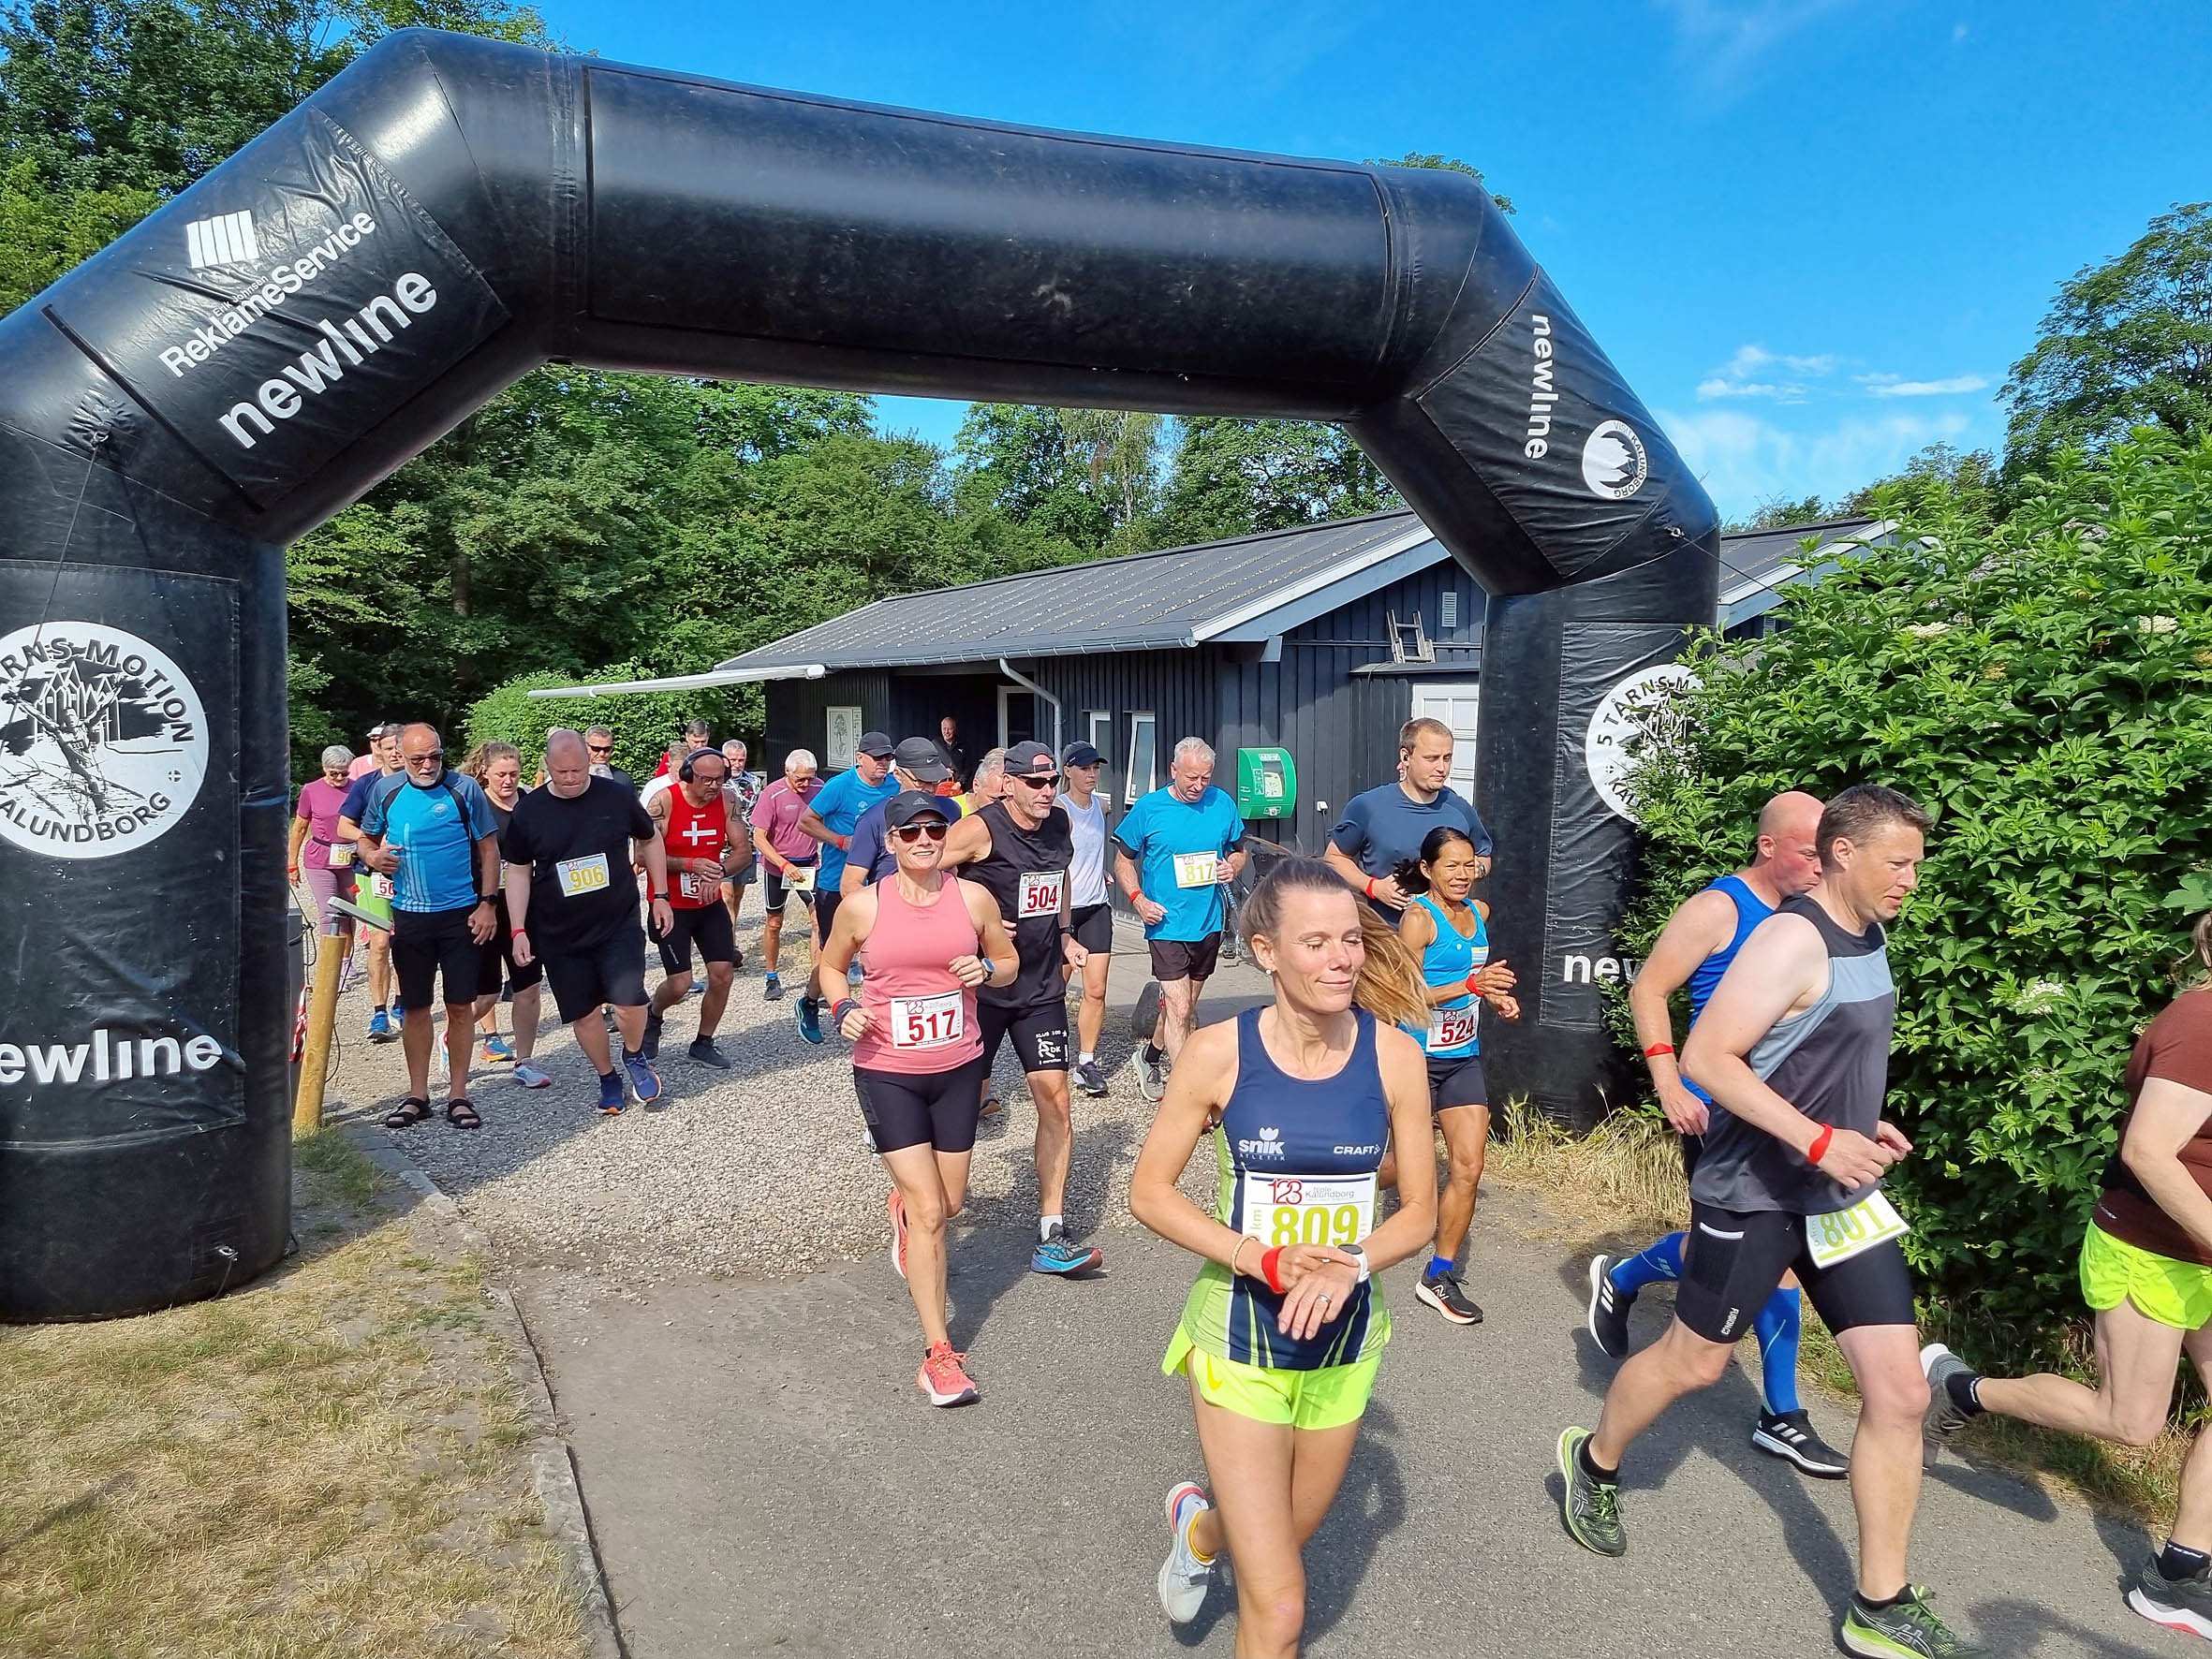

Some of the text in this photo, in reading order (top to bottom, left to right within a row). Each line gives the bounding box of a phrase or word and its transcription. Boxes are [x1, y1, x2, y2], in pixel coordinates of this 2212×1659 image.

[158, 212, 376, 377] ReklameService
[212, 275, 269, 316] Erik Johnsen
[218, 272, 438, 449] newline
[1525, 315, 1559, 460] newline
[1614, 435, 1645, 497] KALUNDBORG
[0, 792, 172, 843] ALUNDBORG
[570, 865, 604, 888] 906
[1185, 862, 1214, 882] 817
[1027, 885, 1057, 908] 504
[908, 1009, 955, 1041] 517
[1440, 1014, 1474, 1043] 524
[1239, 1152, 1286, 1161] ATLETIK
[1334, 1145, 1375, 1155] CRAFT
[1268, 1179, 1303, 1205] 123
[1305, 1189, 1355, 1199] Kalundborg
[1272, 1204, 1359, 1246] 809
[1821, 1199, 1886, 1249] 801
